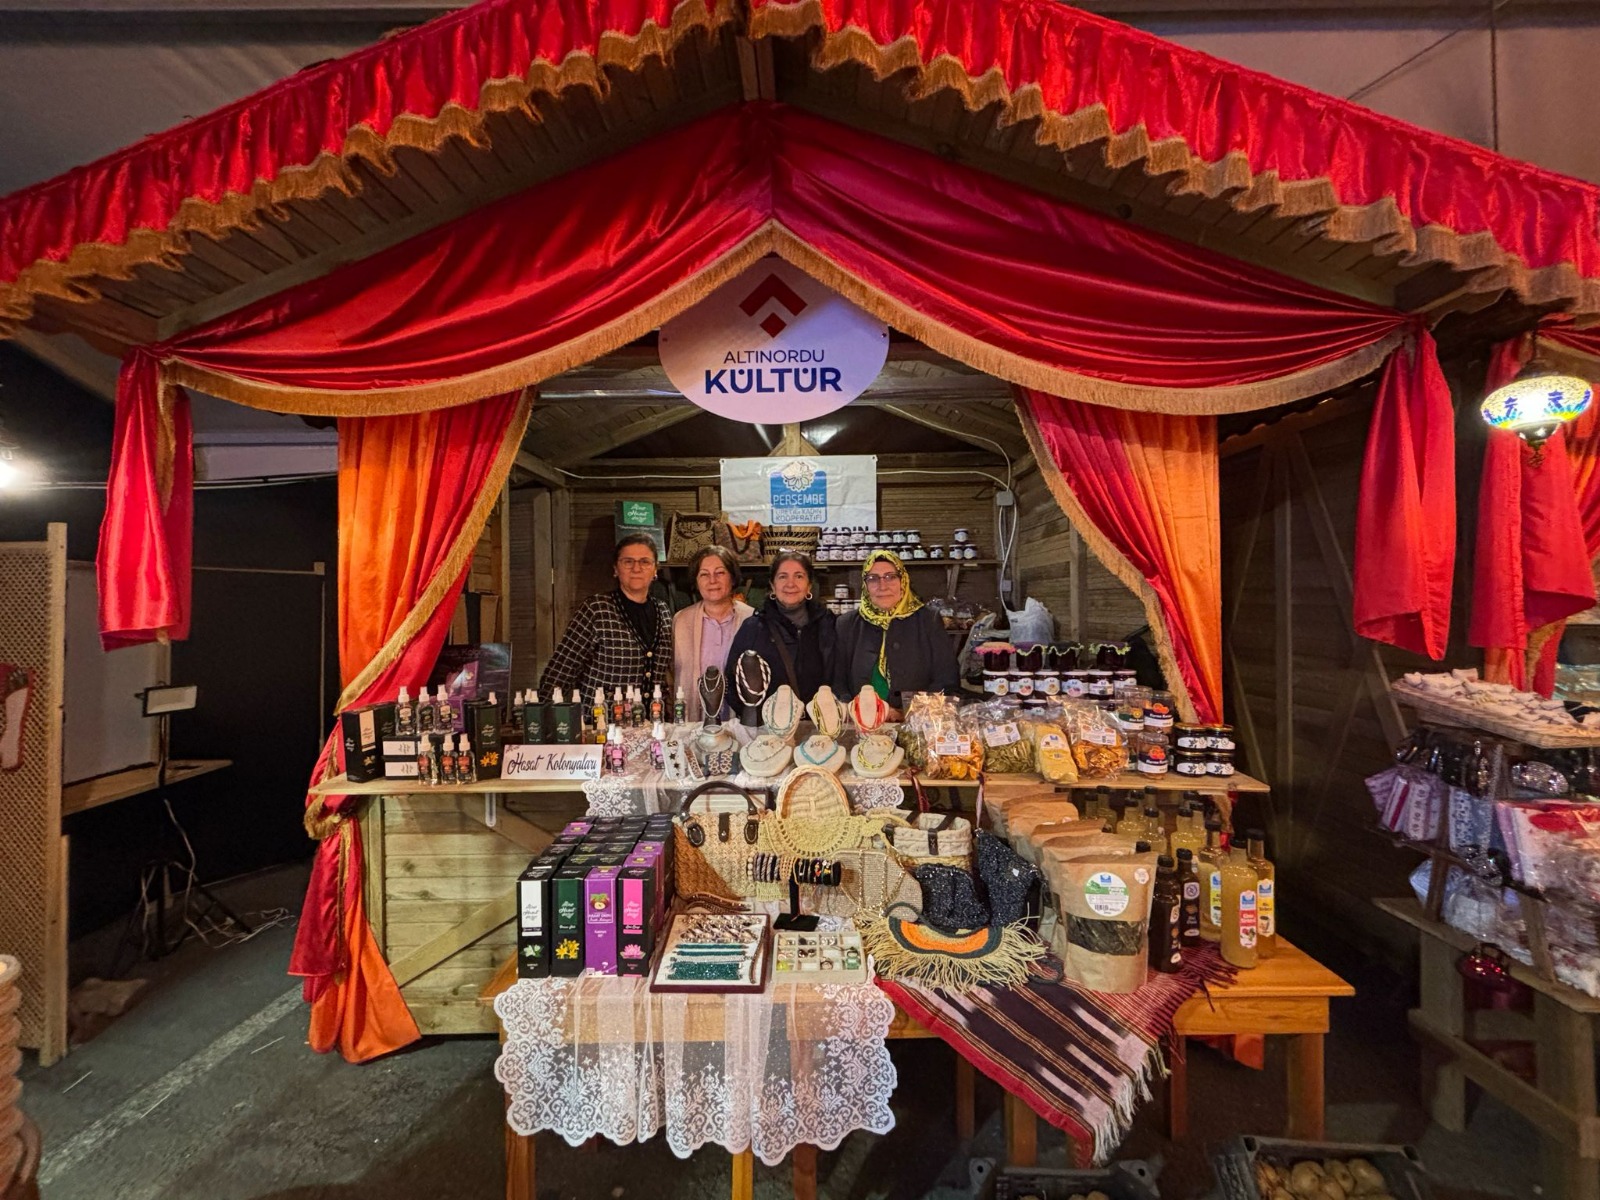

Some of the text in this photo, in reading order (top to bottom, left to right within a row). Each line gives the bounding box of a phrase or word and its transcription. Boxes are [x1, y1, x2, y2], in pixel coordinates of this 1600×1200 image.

[723, 349, 825, 364] ALTINORDU
[705, 367, 843, 394] KÜLTÜR
[507, 752, 597, 775] Hasat Kolonyaları
